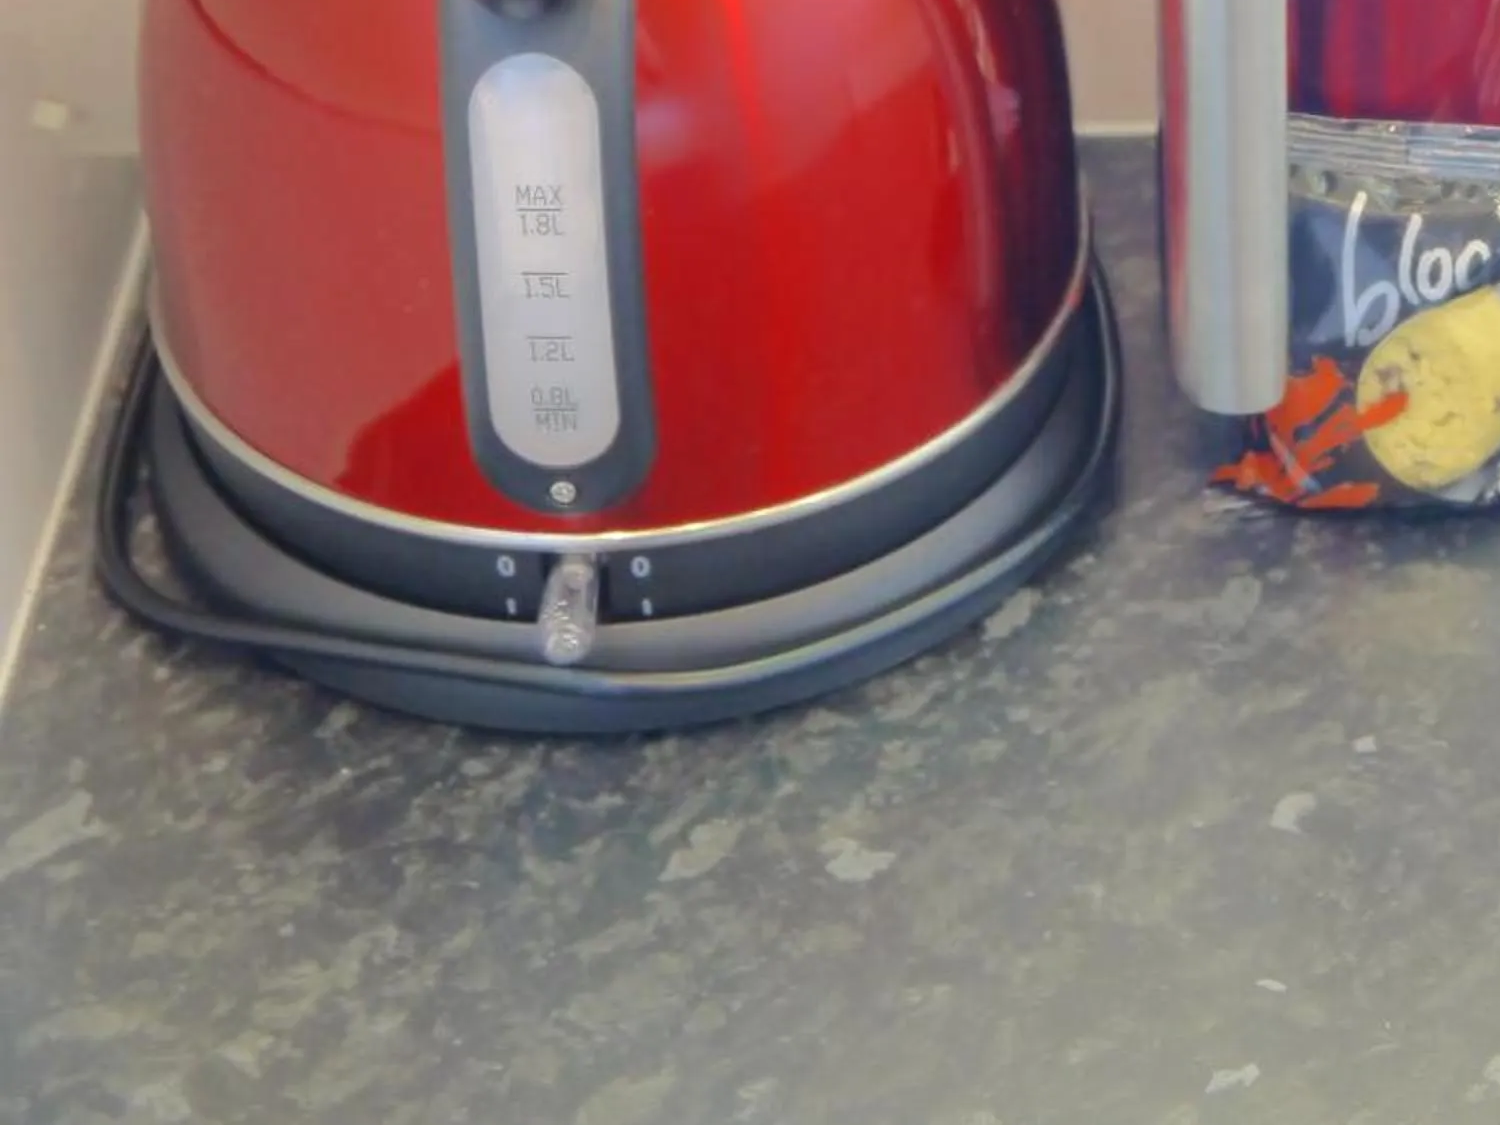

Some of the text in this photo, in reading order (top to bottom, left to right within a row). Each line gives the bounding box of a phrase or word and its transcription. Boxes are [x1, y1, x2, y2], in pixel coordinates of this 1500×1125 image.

[514, 185, 563, 206] MAX
[520, 214, 564, 236] 1.8L
[1342, 190, 1490, 347] bloo
[524, 277, 570, 299] 1.5L
[529, 340, 574, 363] 1.2L
[535, 414, 577, 433] MIN
